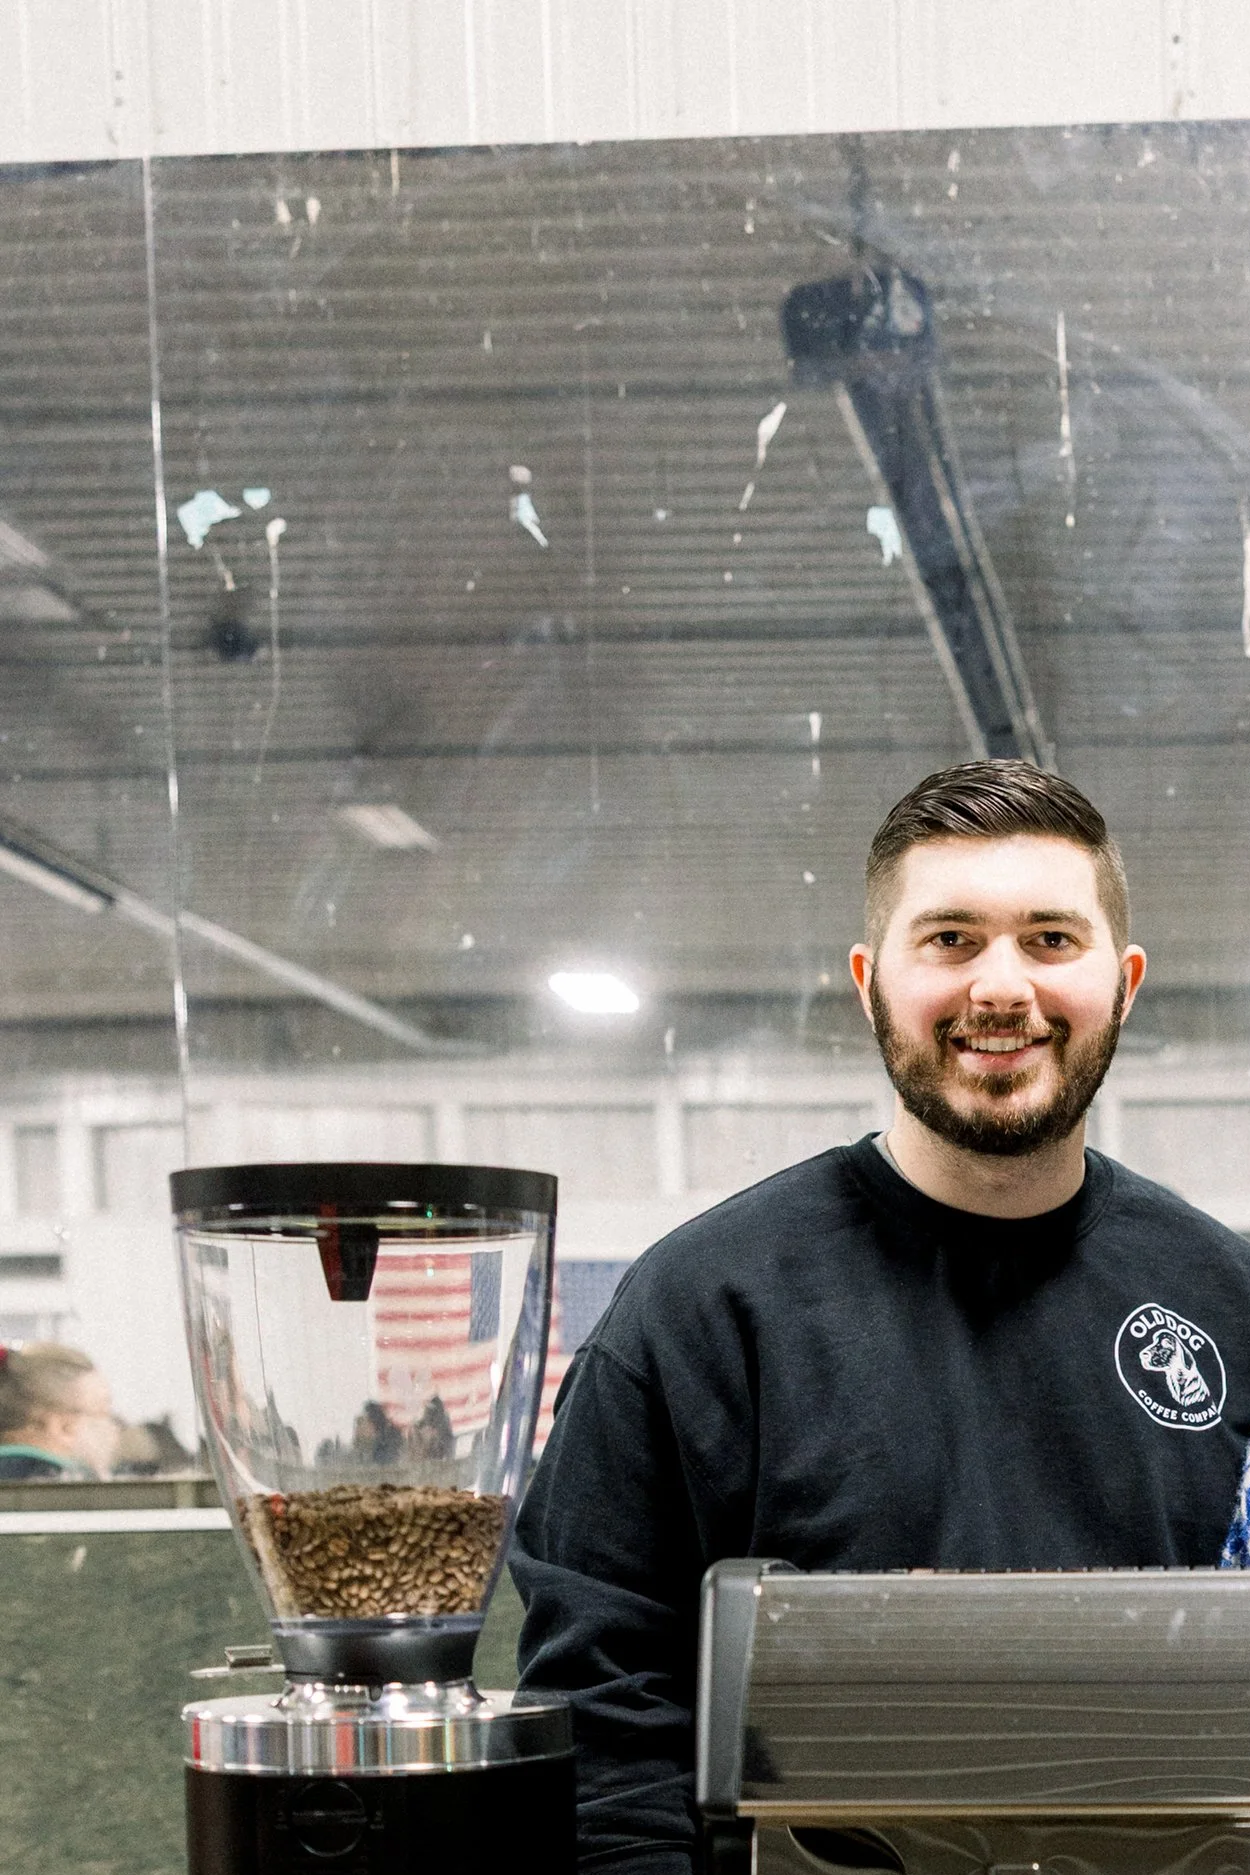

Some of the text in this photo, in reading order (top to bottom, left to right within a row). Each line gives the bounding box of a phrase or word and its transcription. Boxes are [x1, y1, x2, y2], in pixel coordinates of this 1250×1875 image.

[1130, 1309, 1205, 1351] OLD DOG
[1138, 1389, 1218, 1423] COFFEE COMPA
